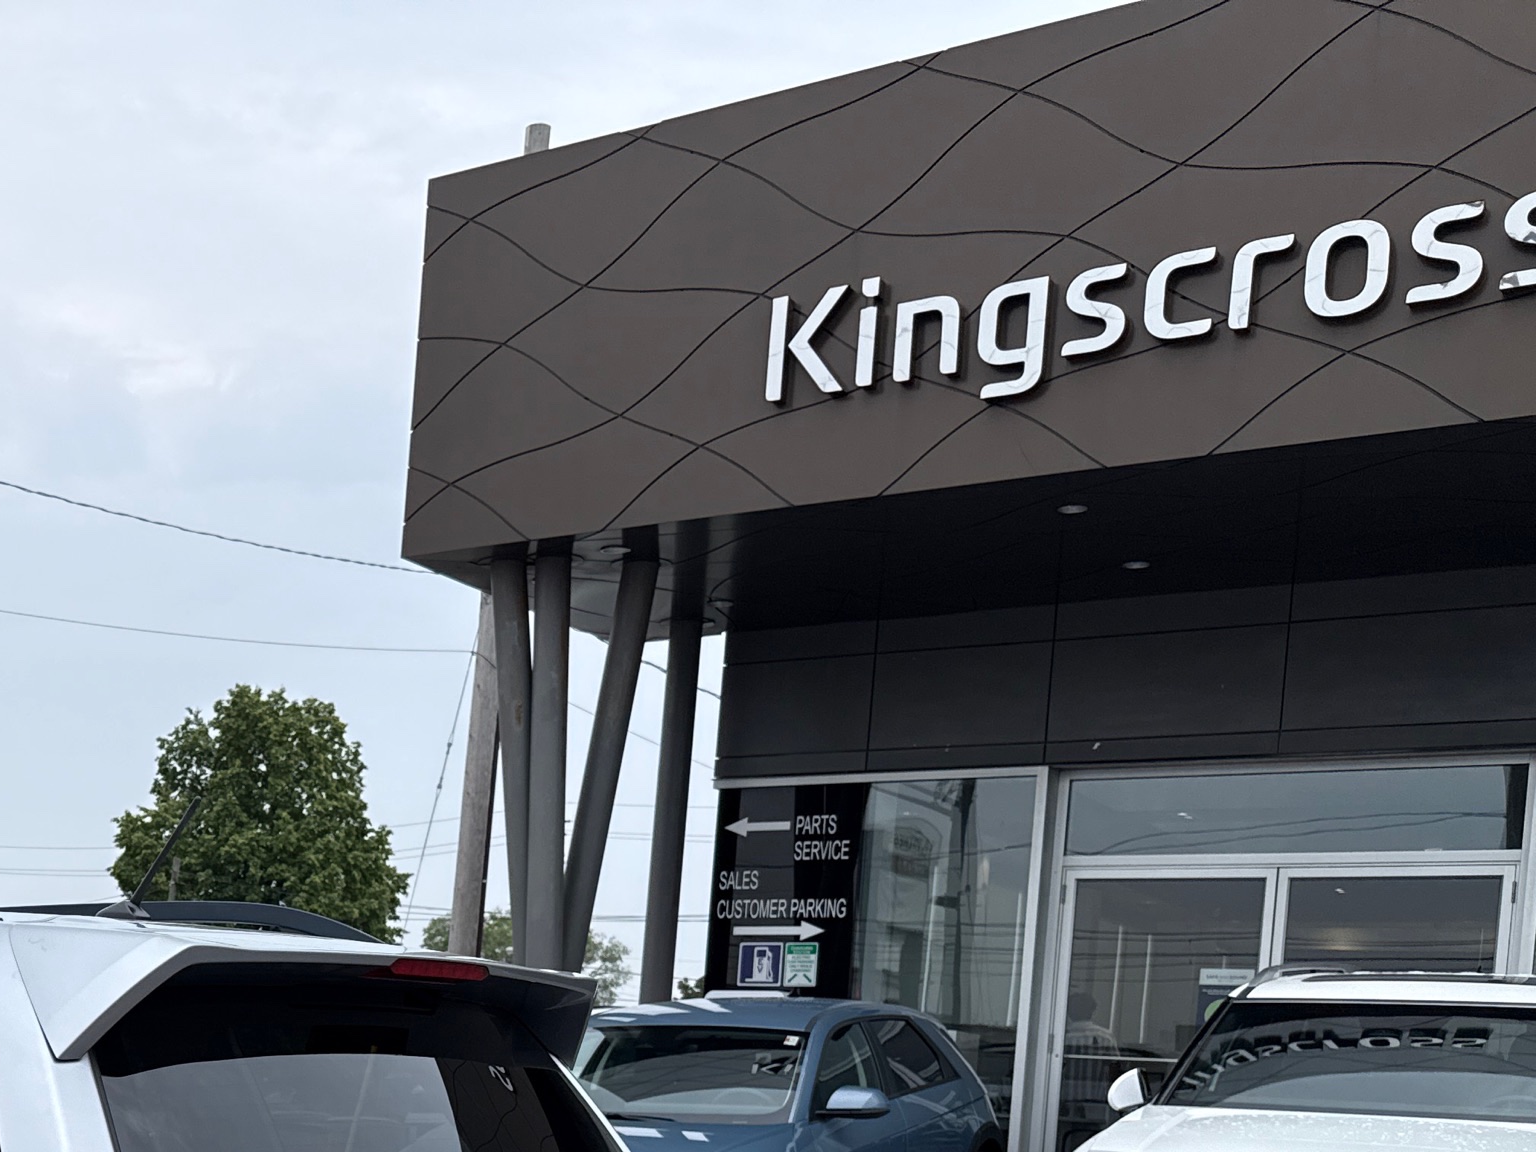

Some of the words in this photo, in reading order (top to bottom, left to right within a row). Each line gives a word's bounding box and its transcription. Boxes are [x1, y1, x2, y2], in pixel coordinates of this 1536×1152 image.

[795, 814, 838, 835] PARTS
[793, 840, 851, 861] SERVICE
[718, 870, 760, 891] SALES
[716, 898, 788, 919] CUSTOMER
[789, 897, 848, 919] PARKING
